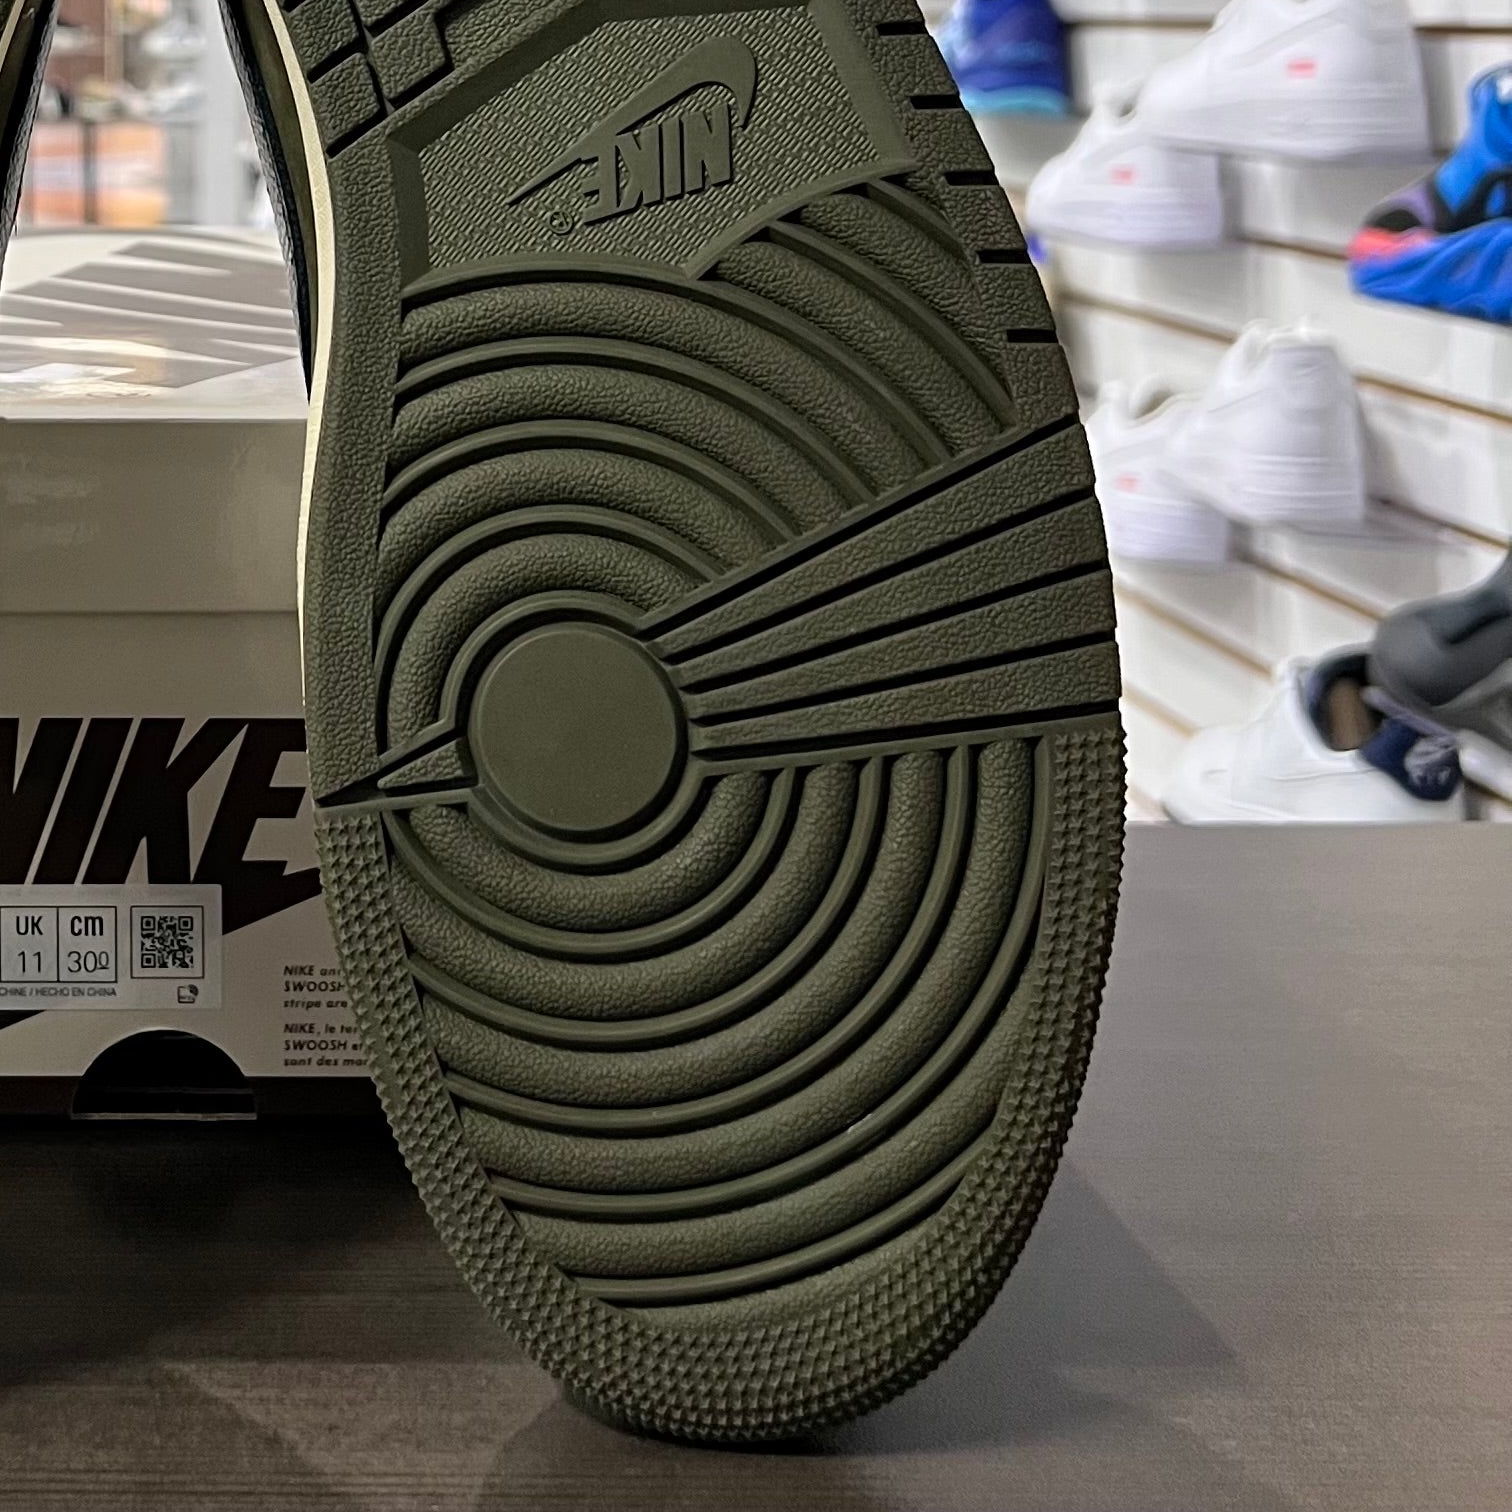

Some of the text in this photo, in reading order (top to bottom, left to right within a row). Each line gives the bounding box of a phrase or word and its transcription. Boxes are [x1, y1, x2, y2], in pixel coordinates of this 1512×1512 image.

[584, 101, 734, 226] NIKE
[16, 915, 44, 936] UK
[70, 915, 104, 937] cm
[17, 951, 42, 974] 11
[284, 965, 315, 976] NIKE
[35, 986, 69, 997] HECHO
[71, 986, 85, 997] EN
[87, 986, 117, 997] CHINA
[284, 999, 348, 1011] stripe are
[284, 1040, 348, 1051] SWOOSH
[284, 1057, 312, 1066] sont
[316, 1055, 339, 1066] des
